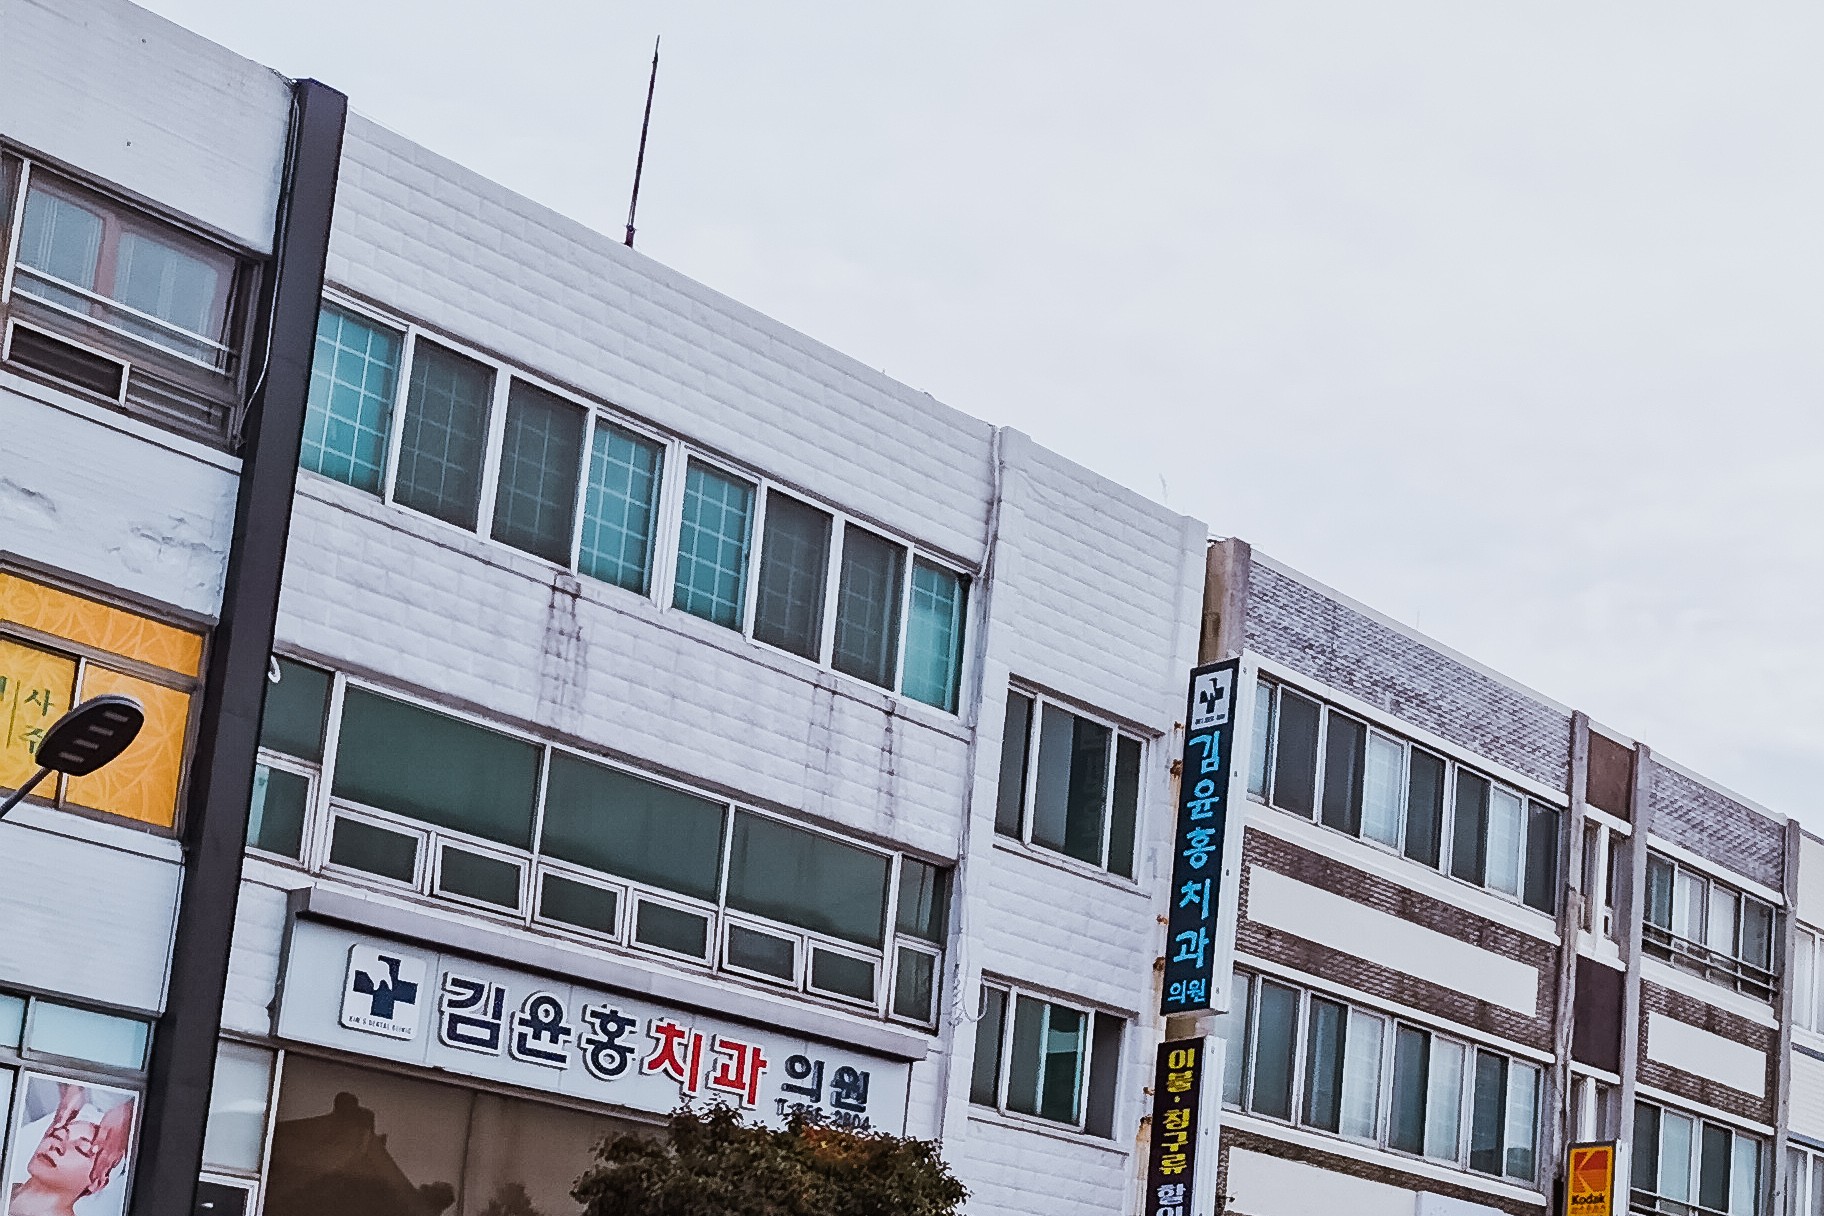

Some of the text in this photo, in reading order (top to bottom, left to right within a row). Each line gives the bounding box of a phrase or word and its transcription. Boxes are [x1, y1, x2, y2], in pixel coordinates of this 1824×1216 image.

[1173, 730, 1221, 969] 김윤홍치과
[1168, 978, 1206, 1005] 의원
[446, 976, 870, 1113] 김윤홍치과 의원
[1571, 1193, 1605, 1205] Kodak
